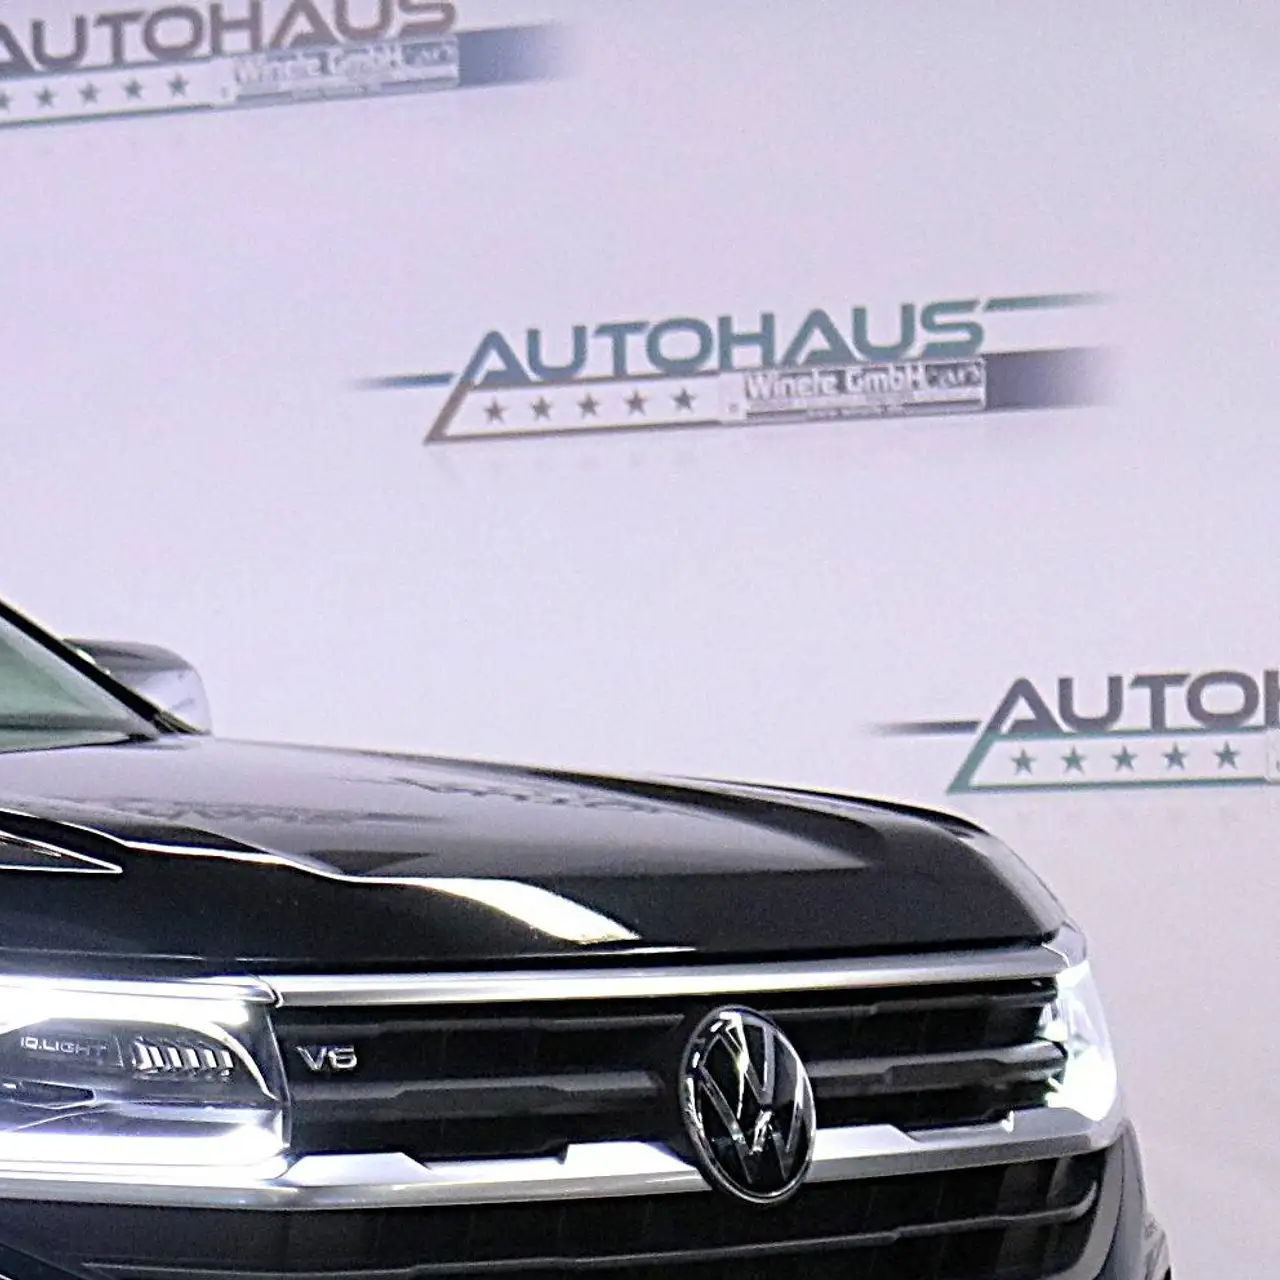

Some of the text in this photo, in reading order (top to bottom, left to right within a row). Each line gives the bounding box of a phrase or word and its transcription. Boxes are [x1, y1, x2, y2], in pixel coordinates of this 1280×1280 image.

[468, 300, 985, 386] AUTOHAUS
[987, 669, 1280, 734] AUTO
[296, 1045, 357, 1070] V6
